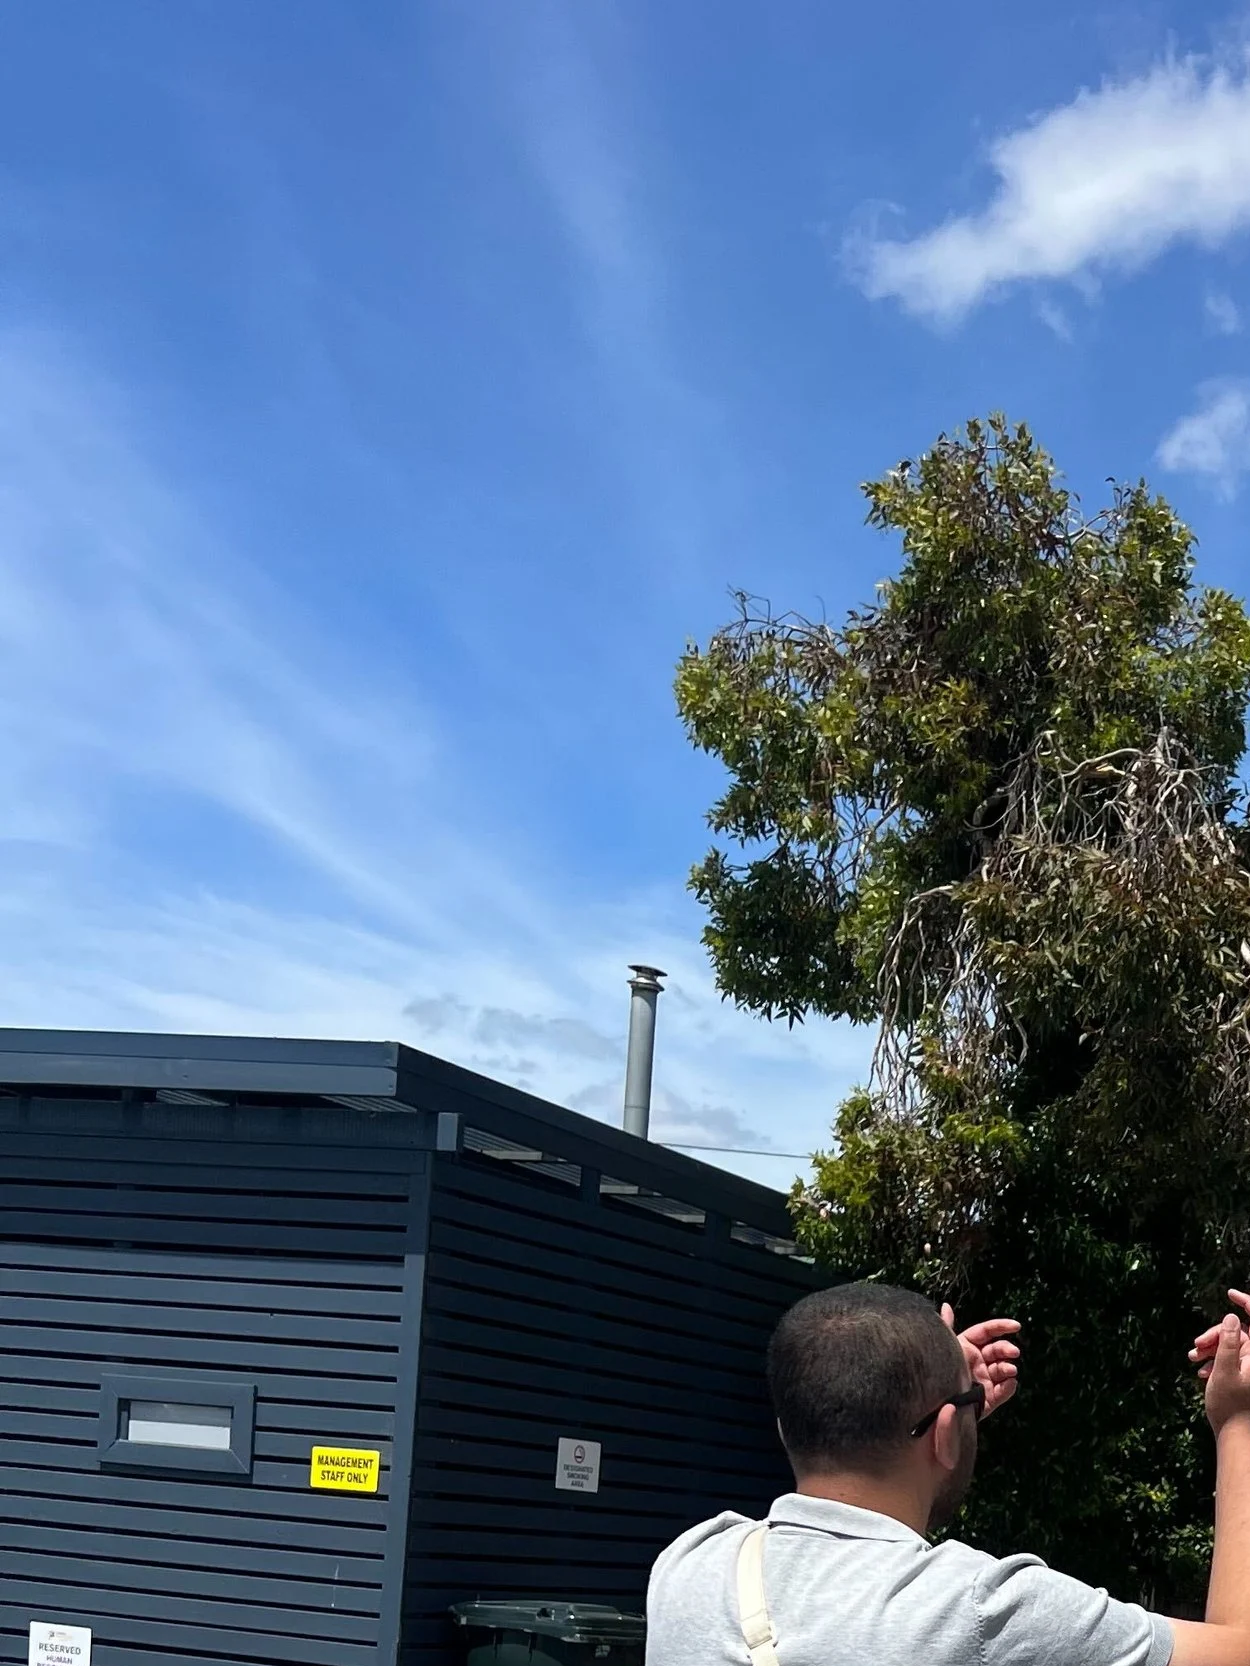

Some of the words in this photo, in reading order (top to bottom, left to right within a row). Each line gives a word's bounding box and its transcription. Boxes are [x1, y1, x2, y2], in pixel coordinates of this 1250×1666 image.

[317, 1455, 374, 1470] MANAGEMENT
[320, 1470, 345, 1482] STAFF
[346, 1472, 368, 1484] ONLY
[38, 1642, 81, 1655] RESERVED
[46, 1655, 72, 1664] HUMAN
